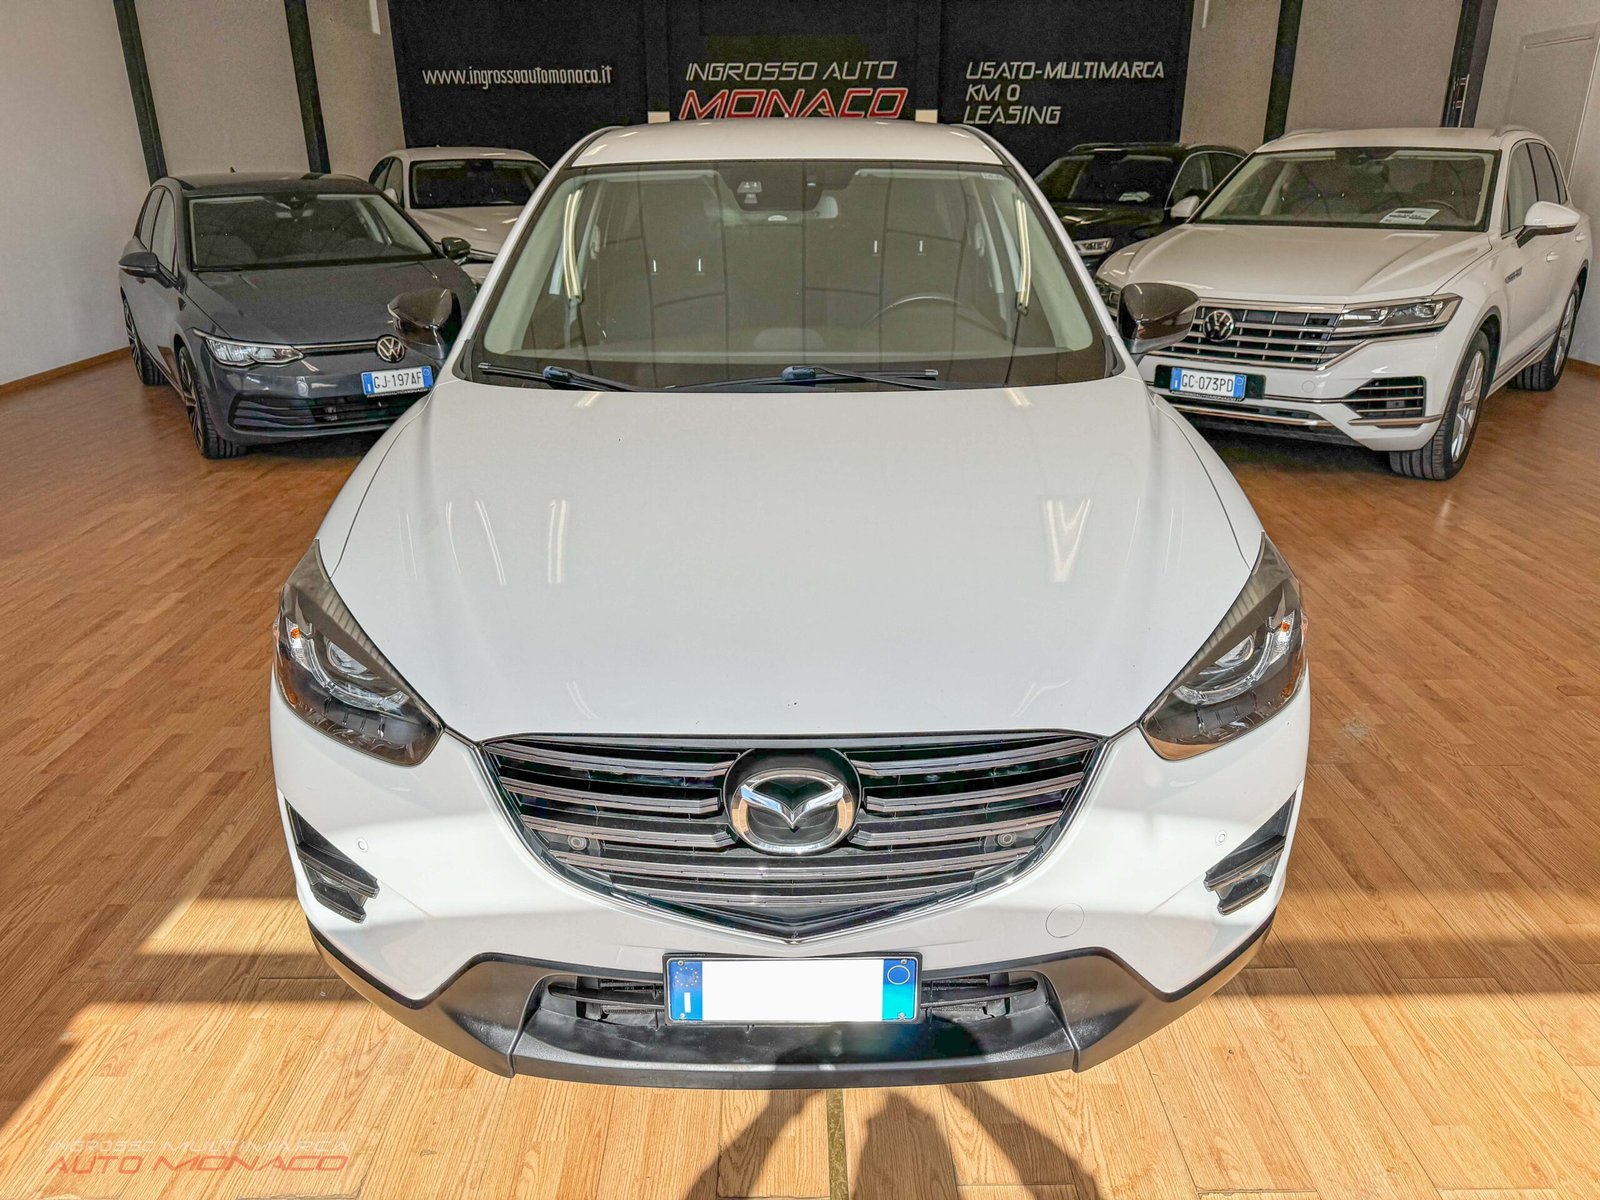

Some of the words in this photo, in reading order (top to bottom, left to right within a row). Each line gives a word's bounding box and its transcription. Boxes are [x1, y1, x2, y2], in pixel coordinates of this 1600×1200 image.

[422, 65, 613, 90] www.ingrossoautomonaco.it
[686, 62, 818, 82] INGROSSO
[823, 60, 898, 81] AUTO
[966, 61, 1165, 80] USATO-MULTIMARCA
[966, 84, 1001, 101] KM
[678, 87, 909, 120] MONACO
[963, 105, 1062, 124] LEASING
